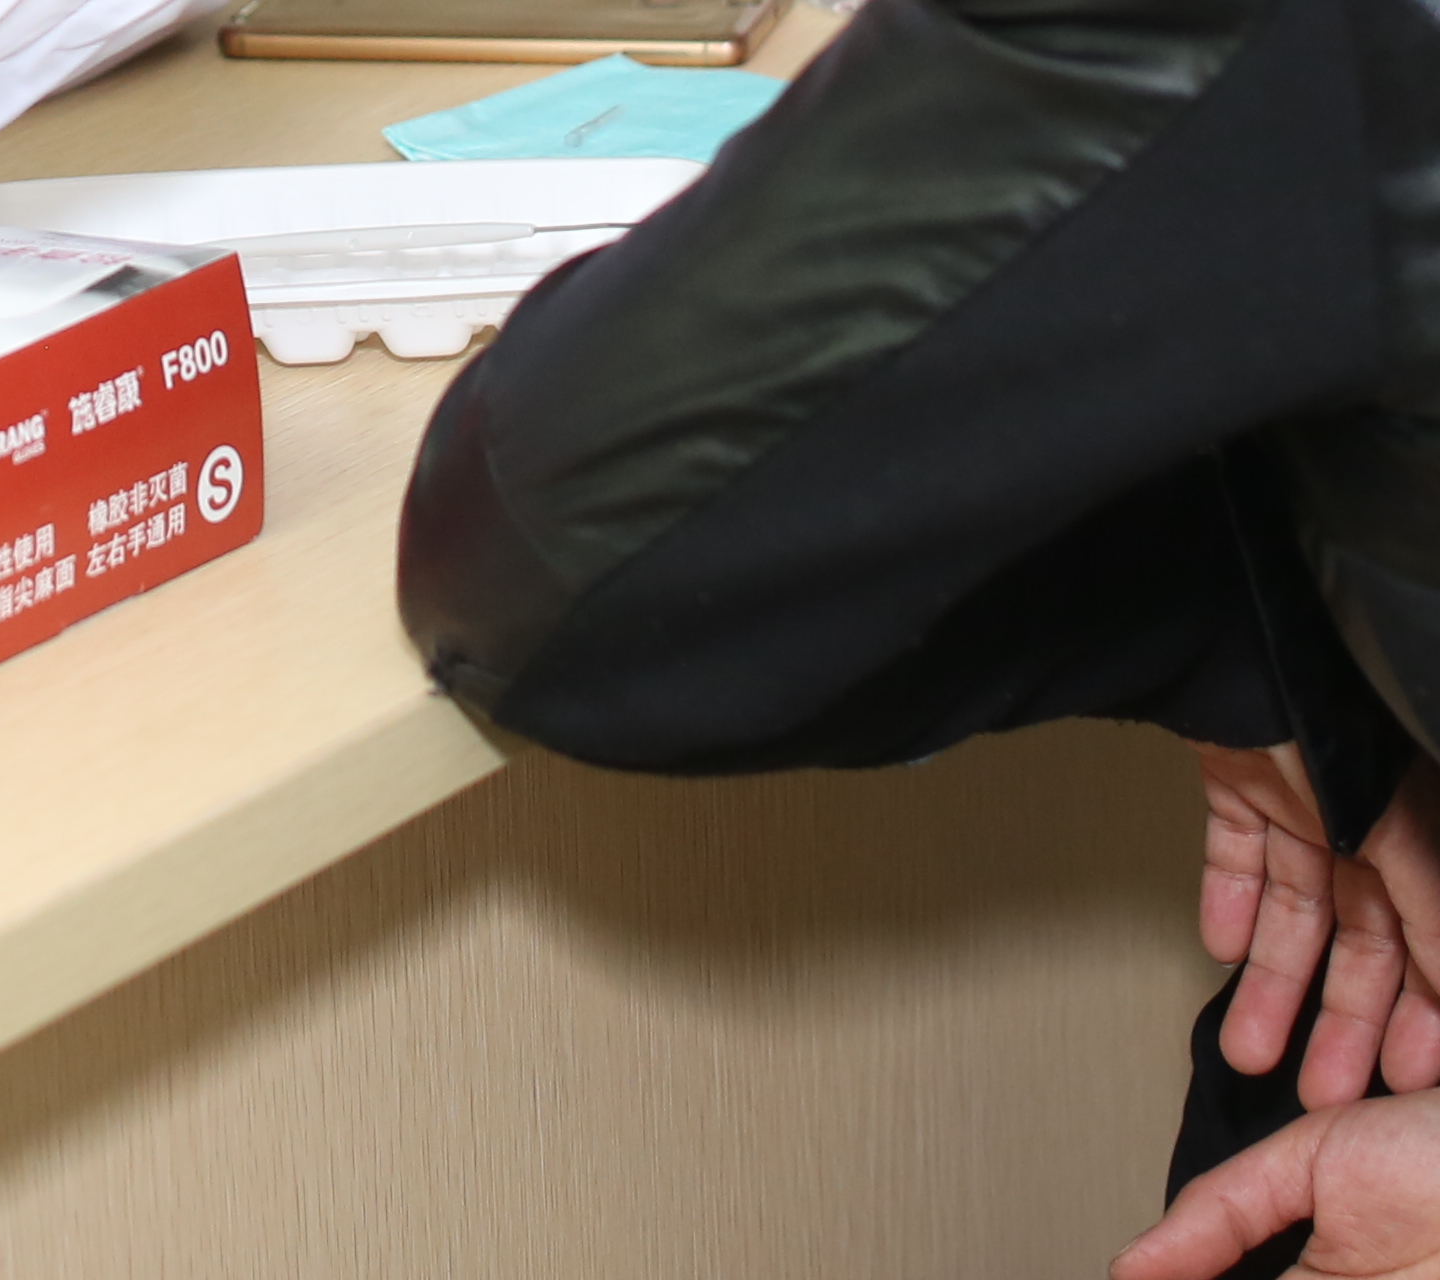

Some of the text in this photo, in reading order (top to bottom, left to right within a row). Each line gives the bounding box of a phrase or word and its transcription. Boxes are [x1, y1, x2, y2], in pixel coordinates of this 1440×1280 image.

[161, 329, 229, 390] F800
[87, 461, 189, 537] 橡胶非灭菌
[85, 501, 187, 578] 左右手通用
